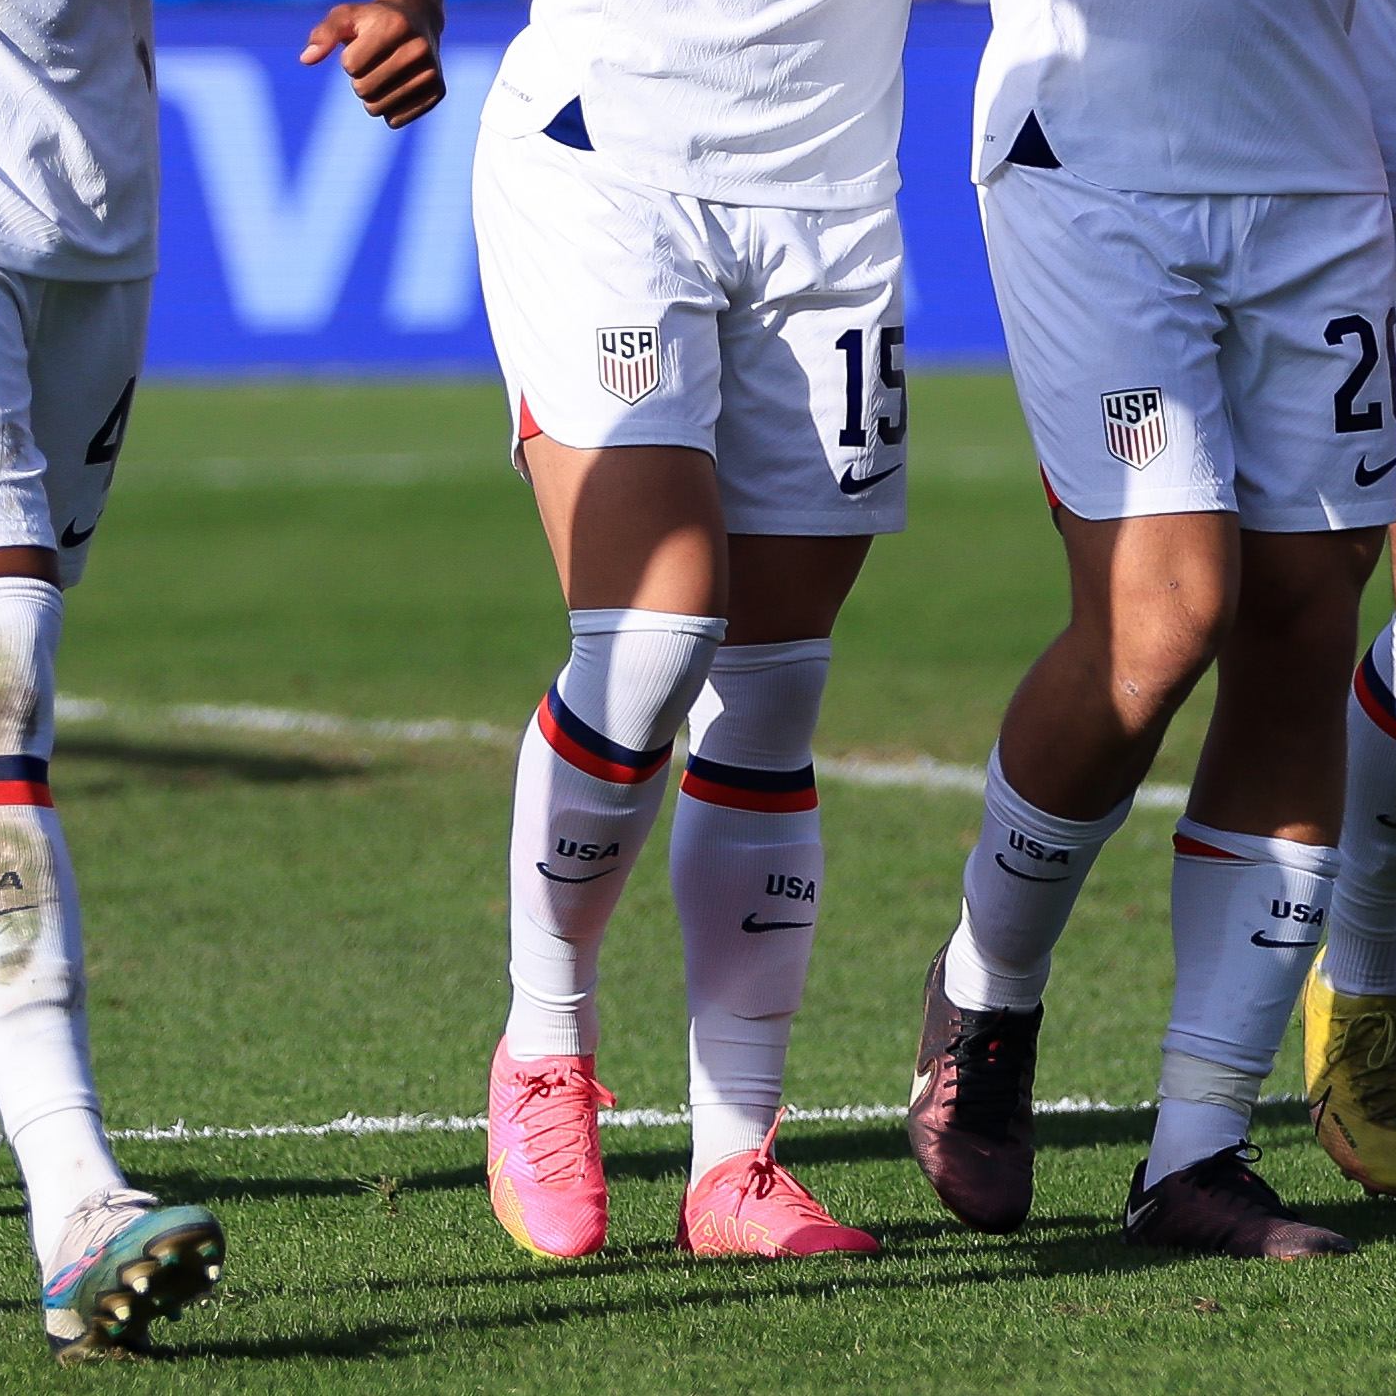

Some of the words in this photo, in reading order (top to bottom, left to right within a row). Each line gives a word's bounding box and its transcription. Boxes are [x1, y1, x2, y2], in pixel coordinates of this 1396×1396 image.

[601, 331, 653, 359] USA
[836, 326, 908, 447] 15
[1106, 391, 1159, 425] USA
[85, 374, 137, 494] 4
[555, 837, 621, 862] USA
[1008, 829, 1070, 865] USA
[764, 873, 816, 903] USA
[1269, 898, 1325, 928] USA
